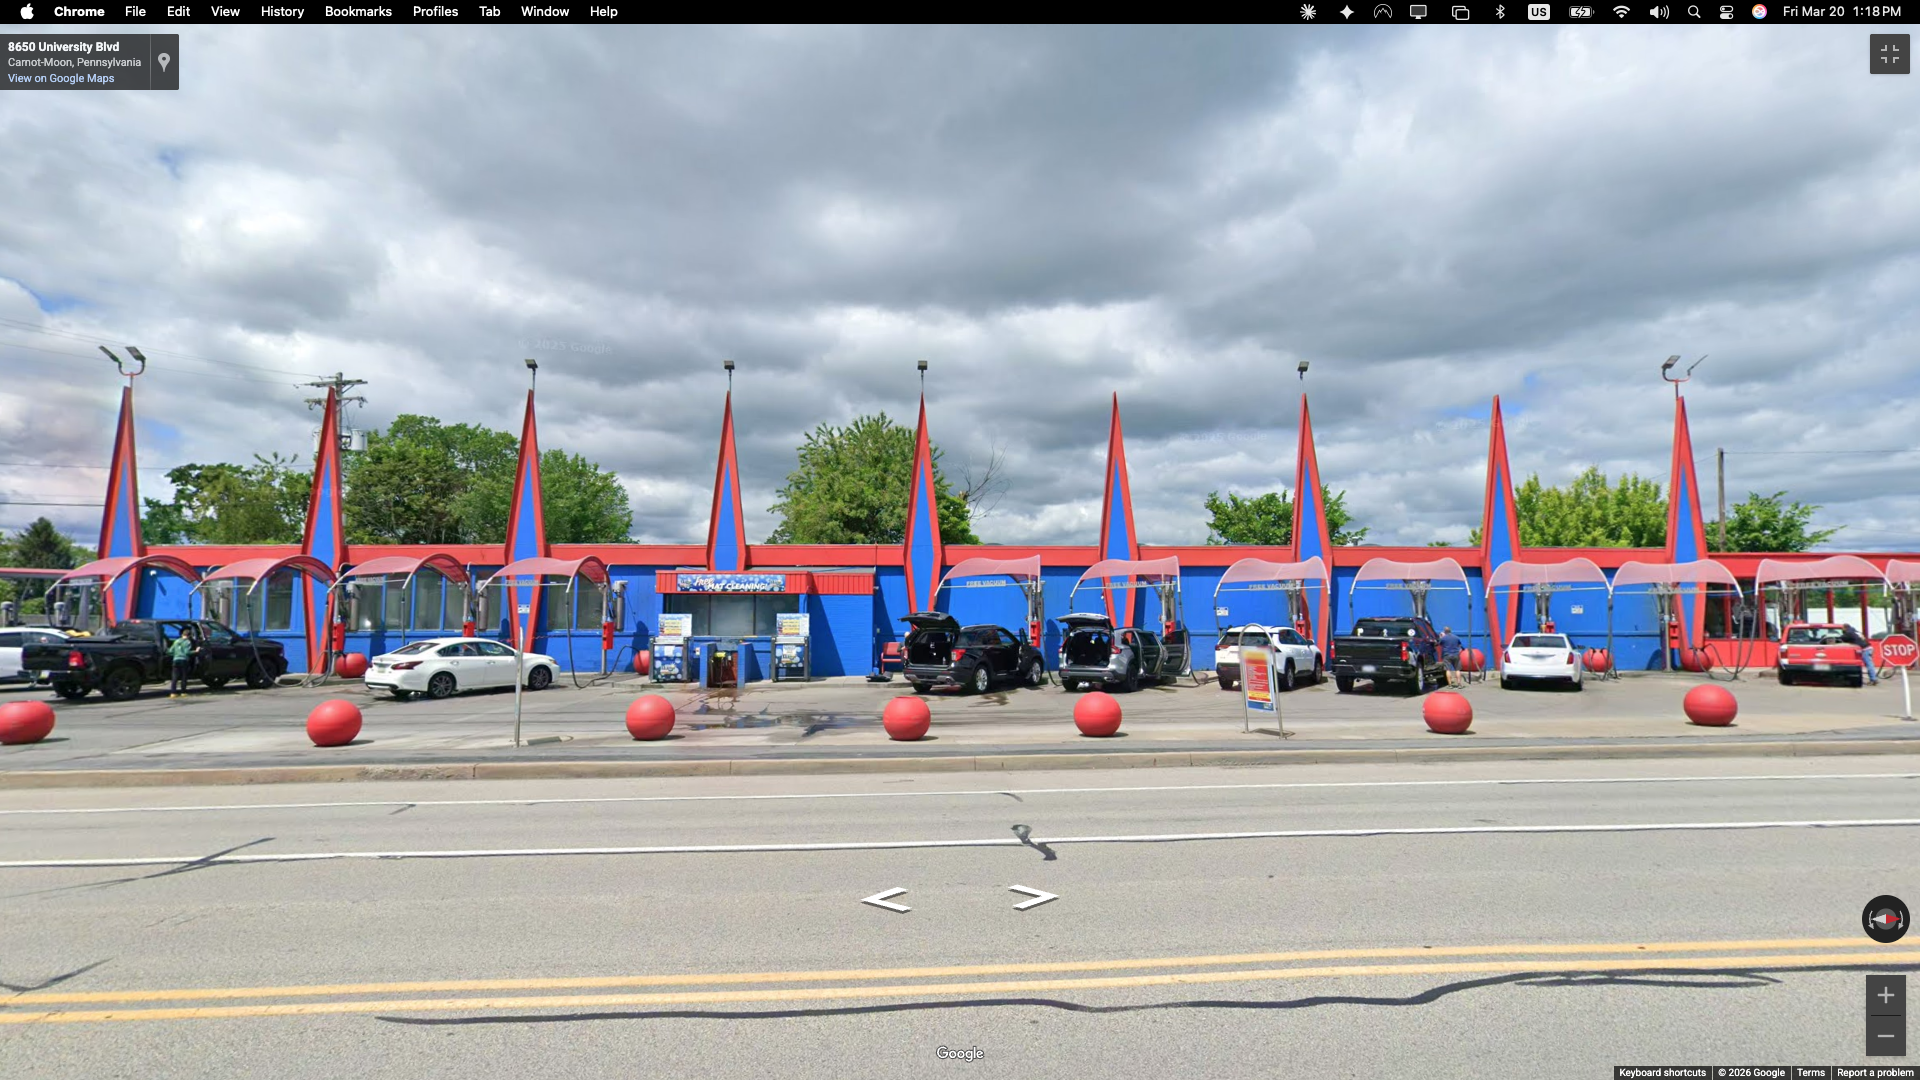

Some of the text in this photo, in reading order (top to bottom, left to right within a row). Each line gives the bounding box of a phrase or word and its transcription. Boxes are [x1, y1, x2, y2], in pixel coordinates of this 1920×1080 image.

[694, 576, 714, 587] Free
[707, 582, 724, 590] MAT
[1883, 644, 1916, 656] STOP
